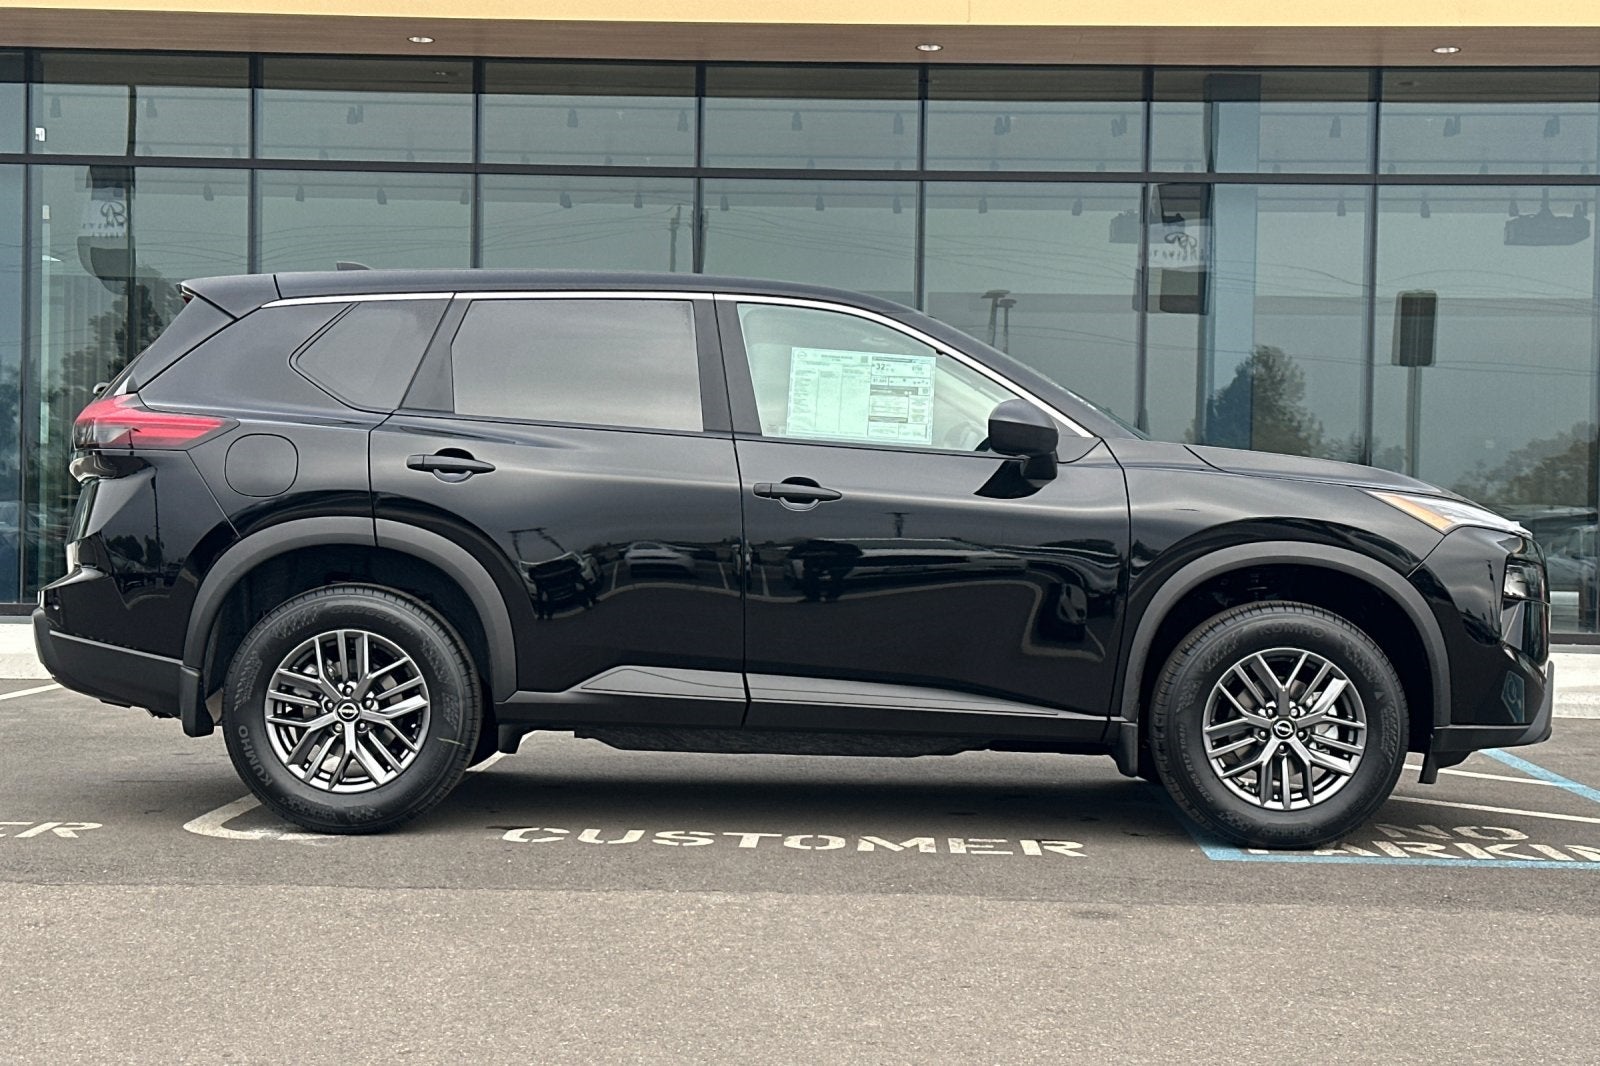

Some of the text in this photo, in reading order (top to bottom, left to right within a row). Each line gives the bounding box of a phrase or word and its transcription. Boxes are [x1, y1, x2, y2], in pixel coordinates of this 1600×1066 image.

[1256, 622, 1325, 639] KUMHO
[238, 725, 274, 787] KUMHO
[501, 827, 1088, 857] CUSTOMER
[1374, 823, 1529, 841] NO
[1247, 840, 1600, 861] ARKI
